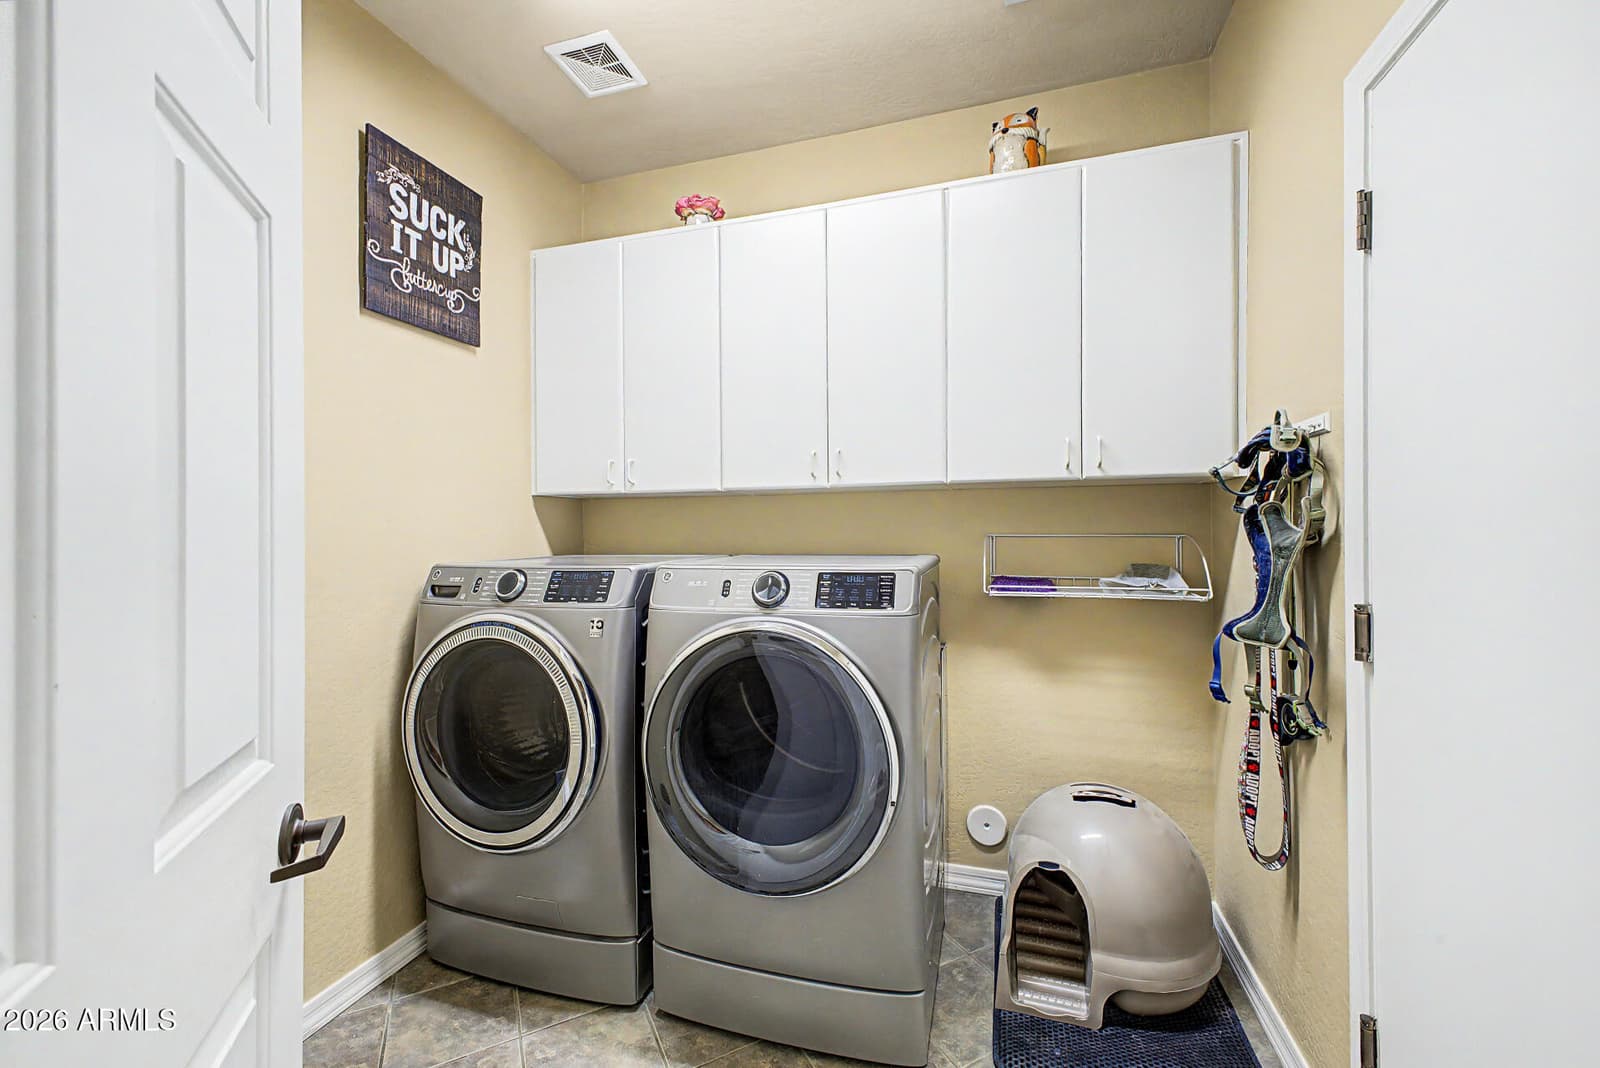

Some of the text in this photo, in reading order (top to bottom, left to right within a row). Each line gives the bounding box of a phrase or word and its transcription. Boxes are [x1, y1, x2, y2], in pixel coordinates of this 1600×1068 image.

[389, 183, 466, 252] SUCK
[390, 219, 465, 279] IT UP
[1248, 729, 1260, 762] ADOPT
[1273, 732, 1283, 768] ADOPT
[1246, 772, 1260, 807] ADOPT
[1244, 815, 1256, 851] ADOPT
